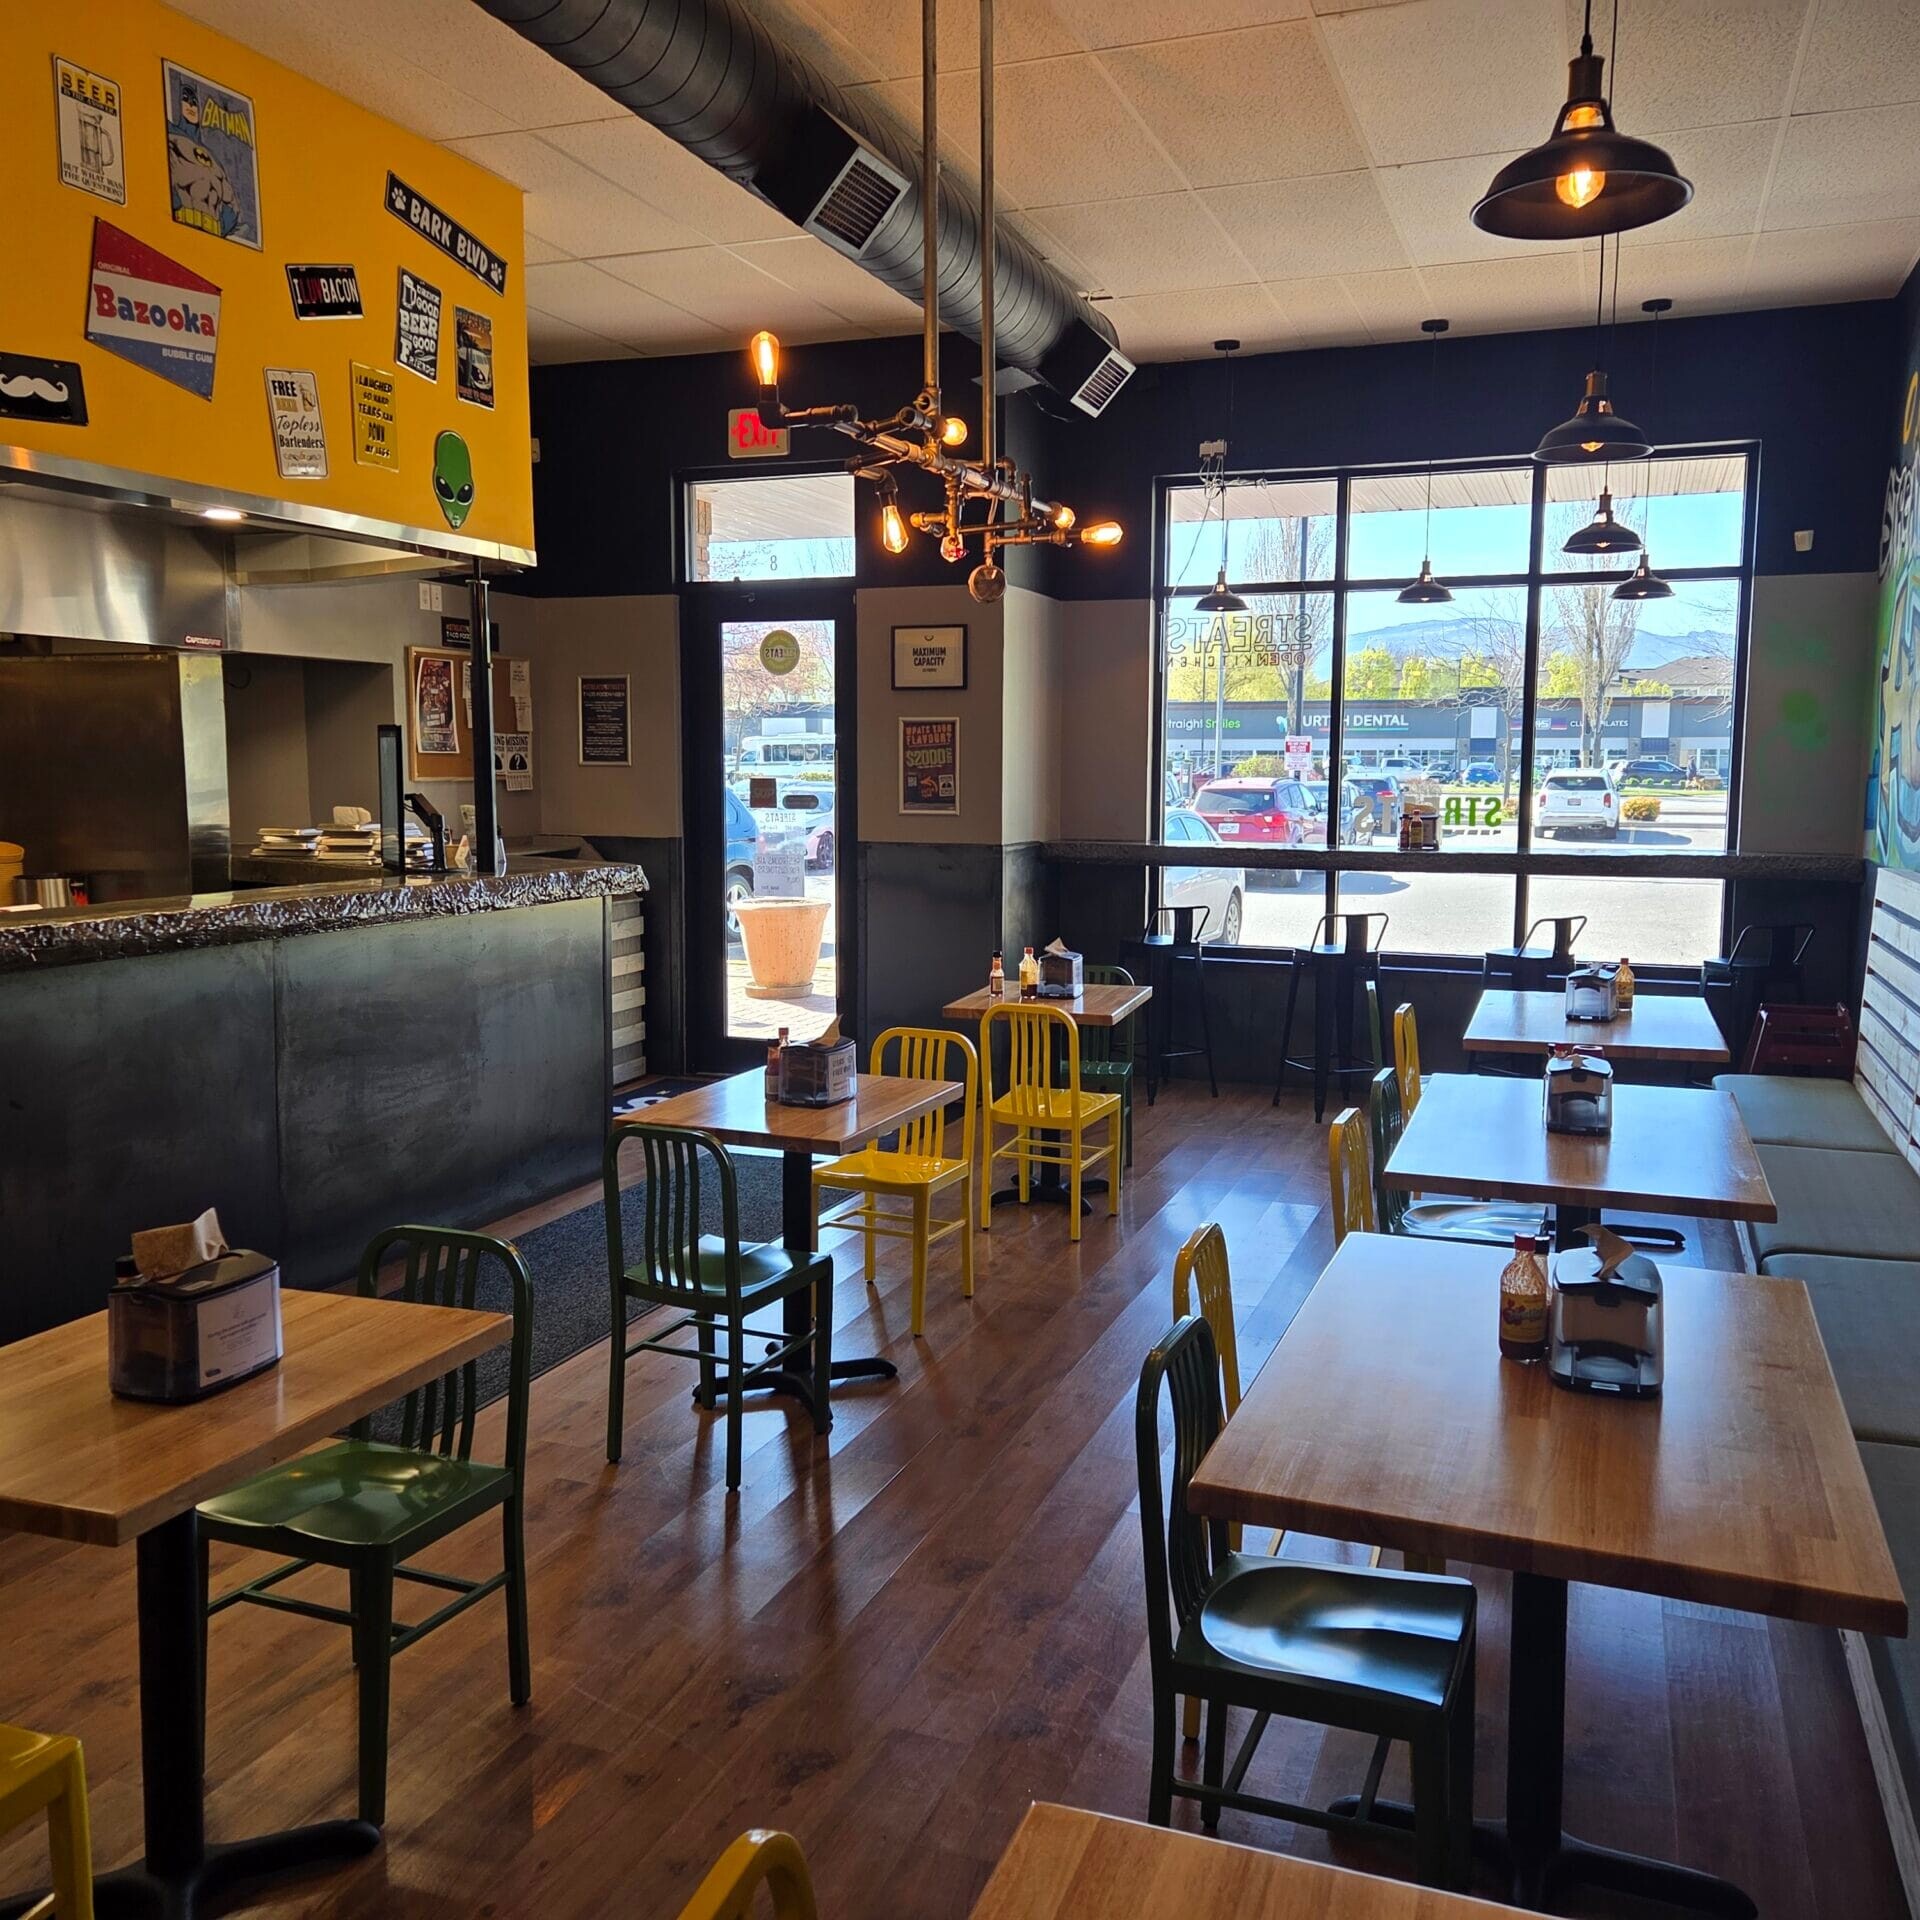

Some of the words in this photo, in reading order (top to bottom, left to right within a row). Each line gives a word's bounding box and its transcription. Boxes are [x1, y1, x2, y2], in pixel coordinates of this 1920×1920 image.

[62, 72, 115, 107] BEER
[201, 98, 253, 149] BATMAN
[410, 198, 452, 248] BARK
[457, 232, 488, 274] BLVD
[320, 277, 359, 304] BACON
[93, 283, 216, 338] Bazooka
[416, 296, 439, 320] GOOD
[400, 308, 438, 340] BEER
[412, 335, 436, 353] GOOD
[162, 347, 194, 361] BUBBLE
[195, 352, 213, 364] GUM
[271, 380, 298, 398] FREE
[276, 415, 320, 436] Topless
[279, 434, 325, 449] Bartenders
[770, 555, 778, 571] 8
[912, 647, 946, 657] MAXIMUM
[913, 656, 945, 667] CAPACITY
[1168, 718, 1204, 731] traight
[1353, 714, 1409, 726] DENTAL
